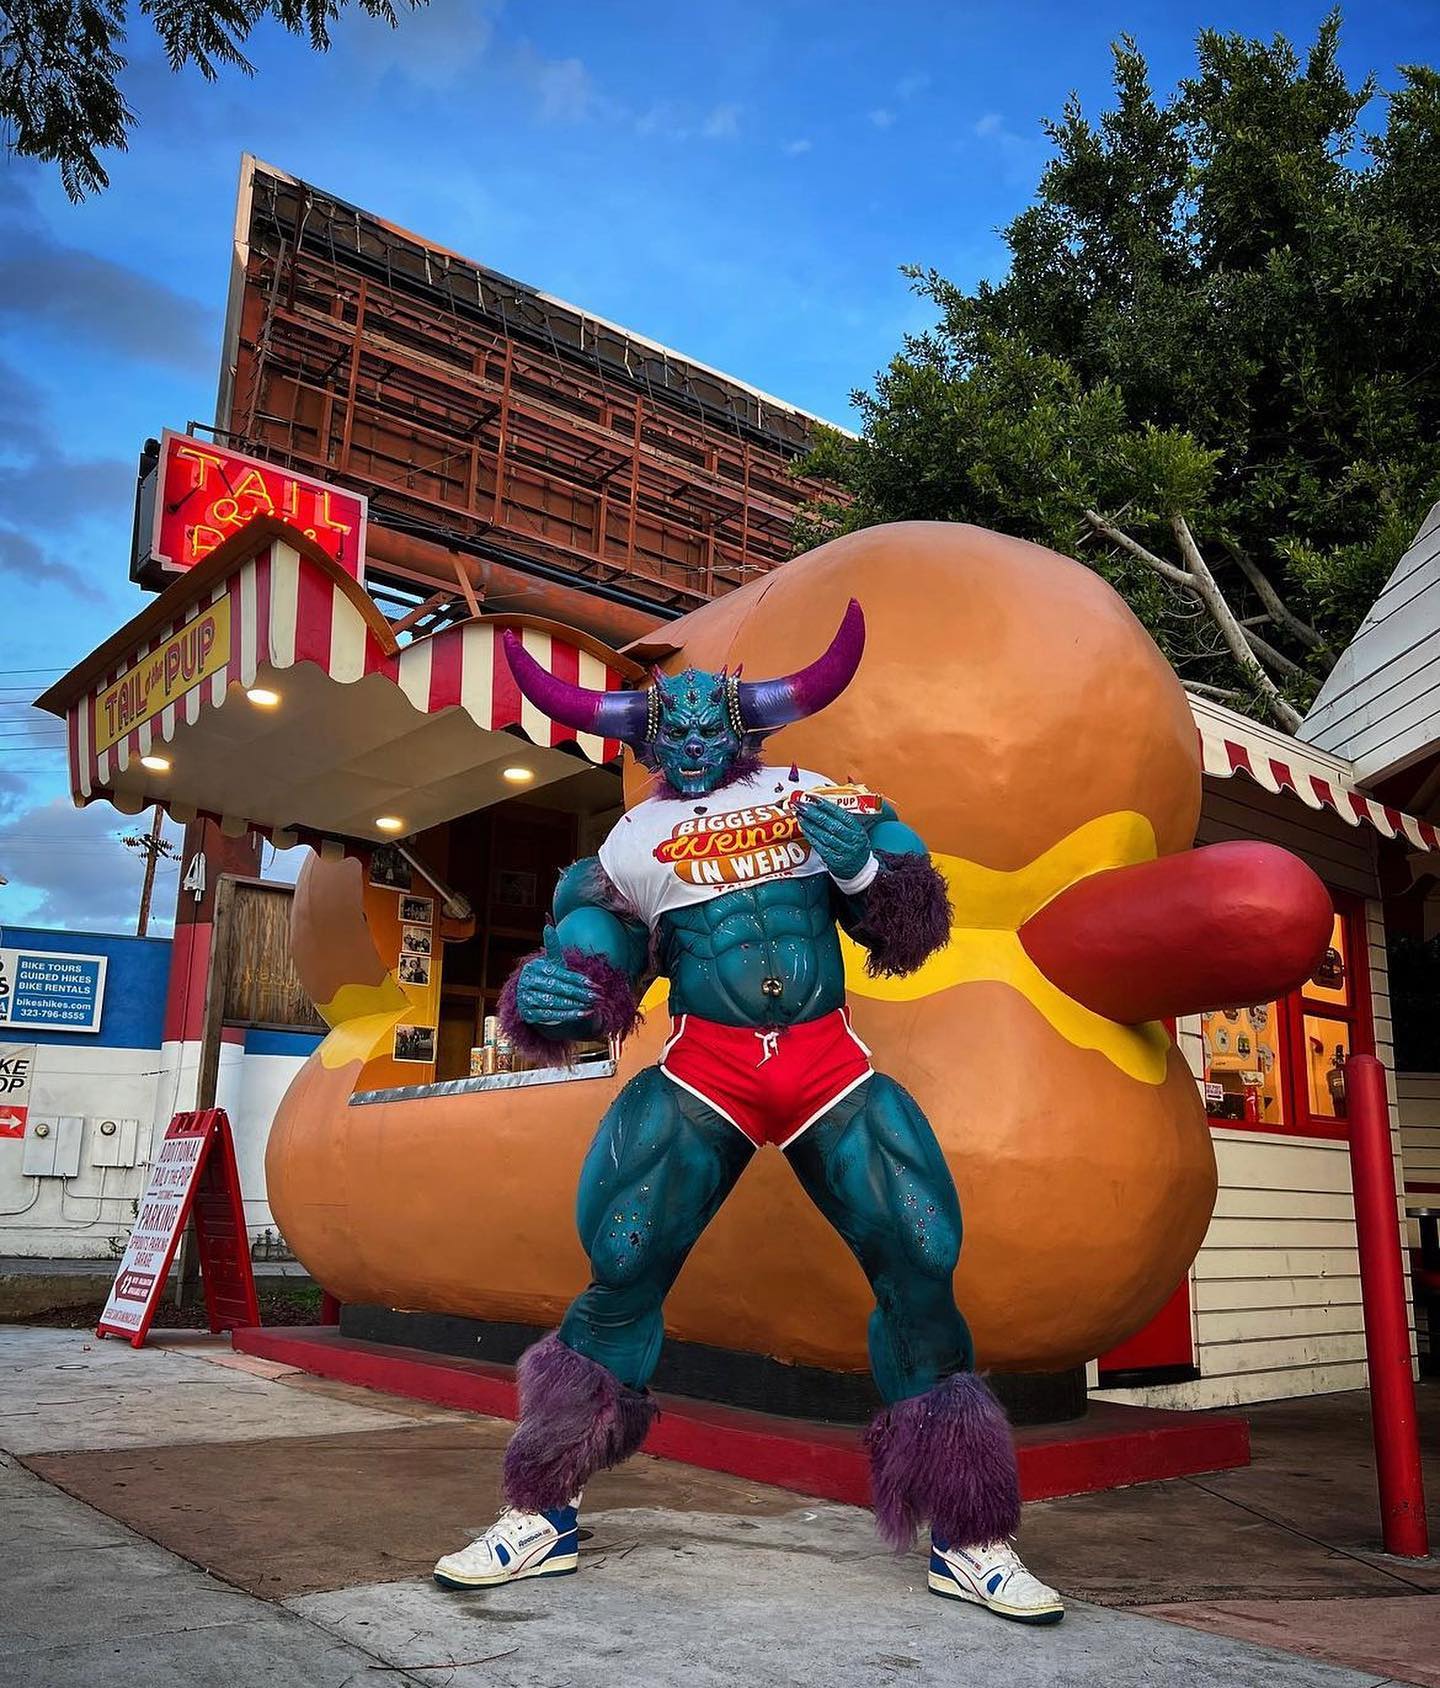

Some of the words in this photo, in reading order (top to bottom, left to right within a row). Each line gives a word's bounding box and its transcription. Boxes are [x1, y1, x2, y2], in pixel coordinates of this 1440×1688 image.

[177, 446, 351, 534] TAIL
[105, 671, 148, 738] TAIL
[165, 616, 216, 696] PUP
[837, 797, 856, 806] PUP
[690, 859, 724, 884] IN
[729, 842, 805, 880] WEHO
[21, 960, 45, 971] BIKE
[47, 963, 82, 973] TOURS
[20, 971, 59, 981] GUIDED
[61, 974, 92, 984] HIKES
[18, 981, 43, 991] BIKE
[45, 983, 91, 995] RENTALS
[16, 998, 92, 1010] bikeshikes.com
[20, 1008, 86, 1020] 323-796-8555
[159, 1140, 201, 1163] ADDITIONAL
[138, 1203, 178, 1232] PARKING
